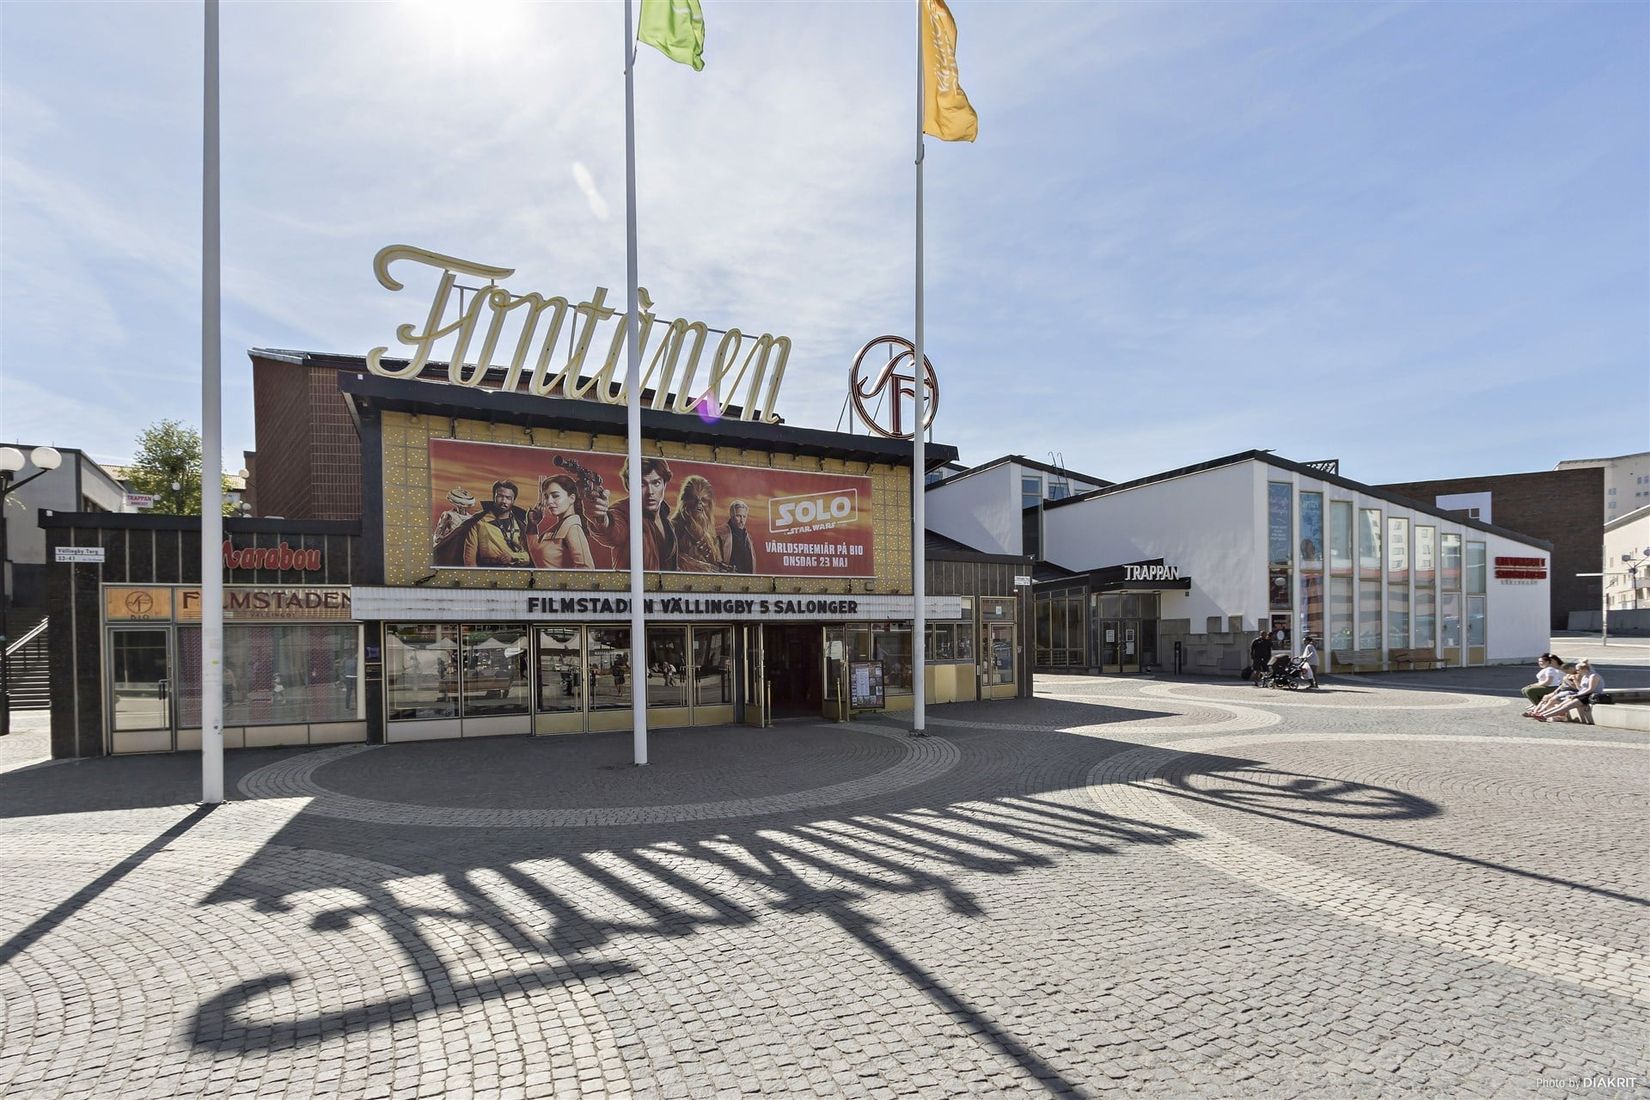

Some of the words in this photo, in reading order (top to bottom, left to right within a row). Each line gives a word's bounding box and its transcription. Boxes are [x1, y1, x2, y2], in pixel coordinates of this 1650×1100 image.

[775, 496, 852, 527] SOLO
[812, 522, 837, 532] WARS
[765, 540, 835, 554] VÄRLDSPREMIÄR
[837, 542, 848, 555] PÅ
[849, 545, 864, 556] BIO
[783, 556, 818, 567] ONSDAG
[820, 557, 831, 567] 23
[832, 557, 849, 568] MAJ
[1123, 565, 1180, 580] TRAPPAN
[183, 591, 352, 609] FMSTADEN
[528, 597, 654, 614] FILMSTADN
[660, 596, 753, 614] VÄLLINGBY
[760, 599, 770, 614] 5
[774, 599, 858, 614] SALONGER
